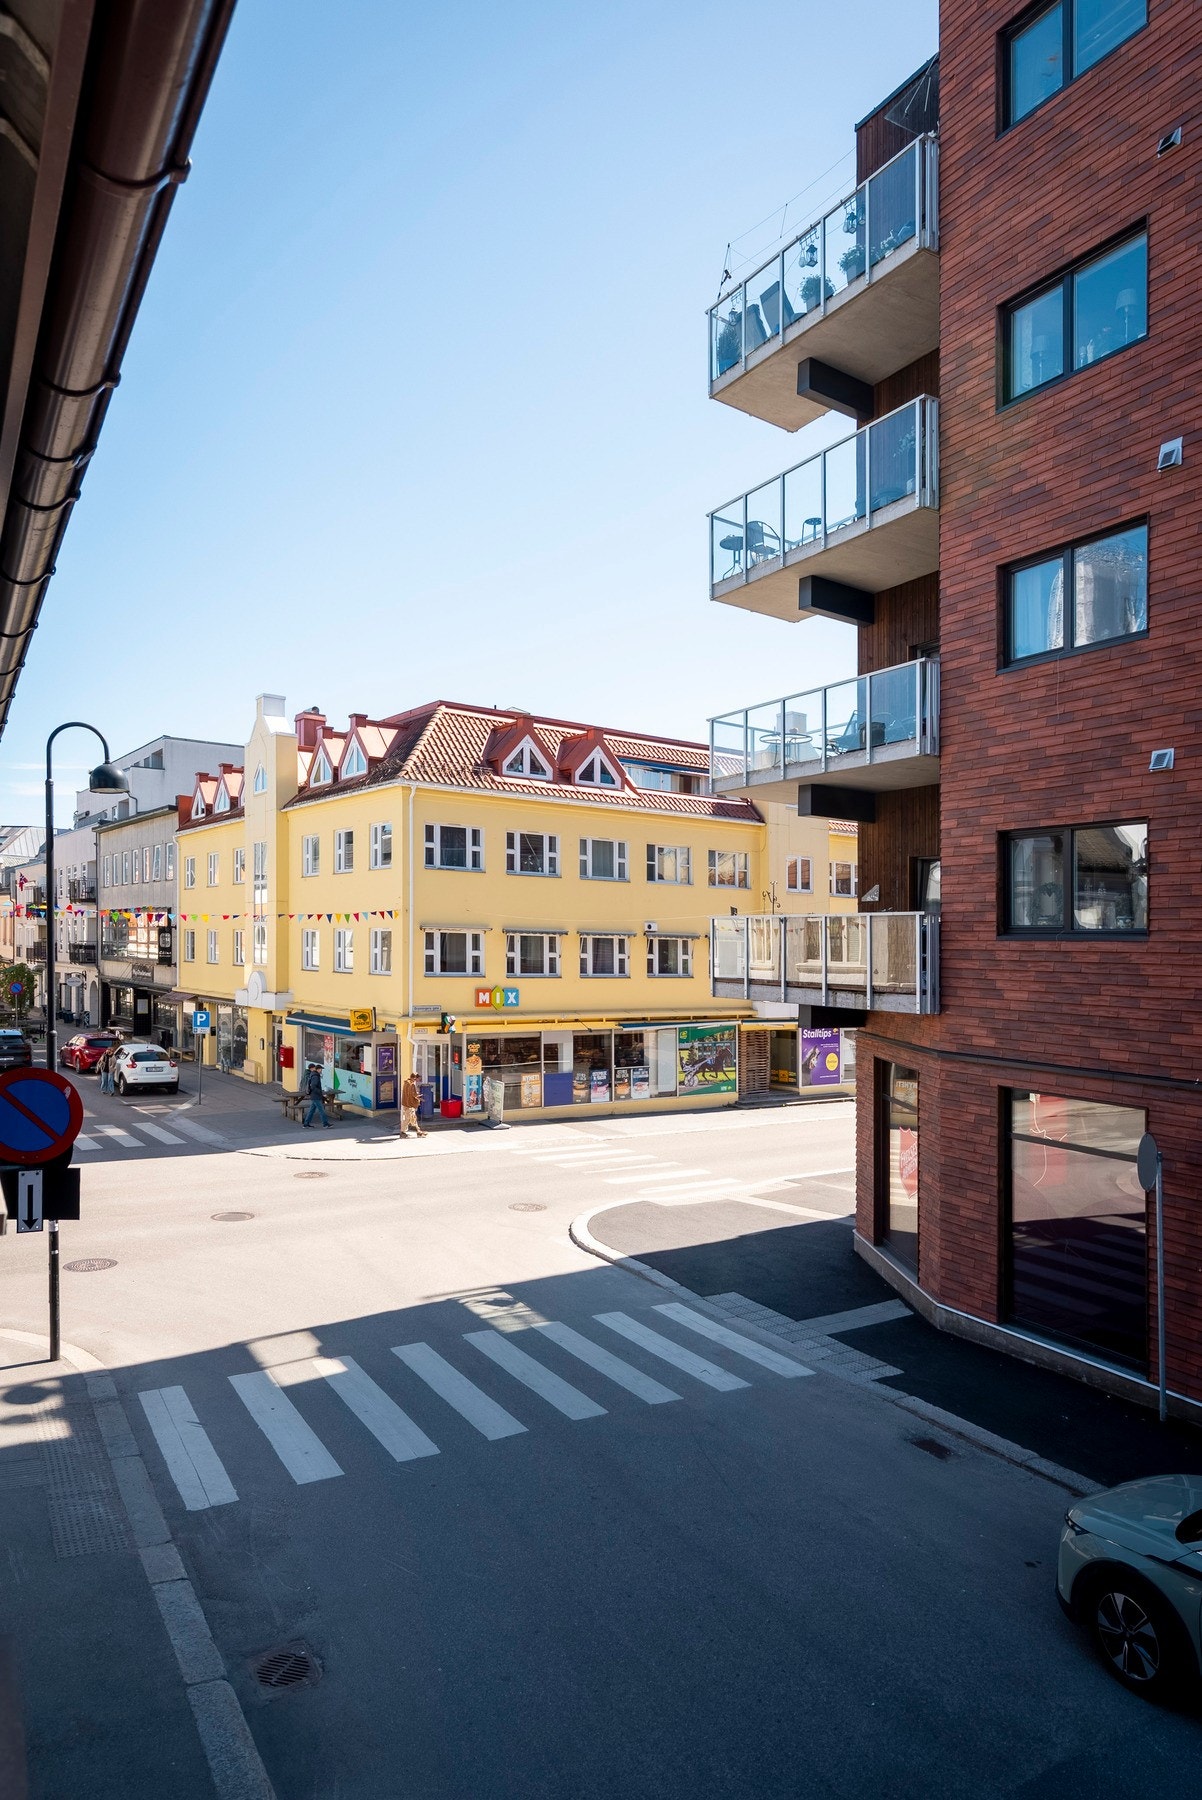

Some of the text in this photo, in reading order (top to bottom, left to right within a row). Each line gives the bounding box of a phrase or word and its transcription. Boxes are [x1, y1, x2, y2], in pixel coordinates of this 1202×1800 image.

[478, 991, 517, 1004] MIX
[196, 1013, 207, 1026] P
[802, 1028, 832, 1040] Stalltips
